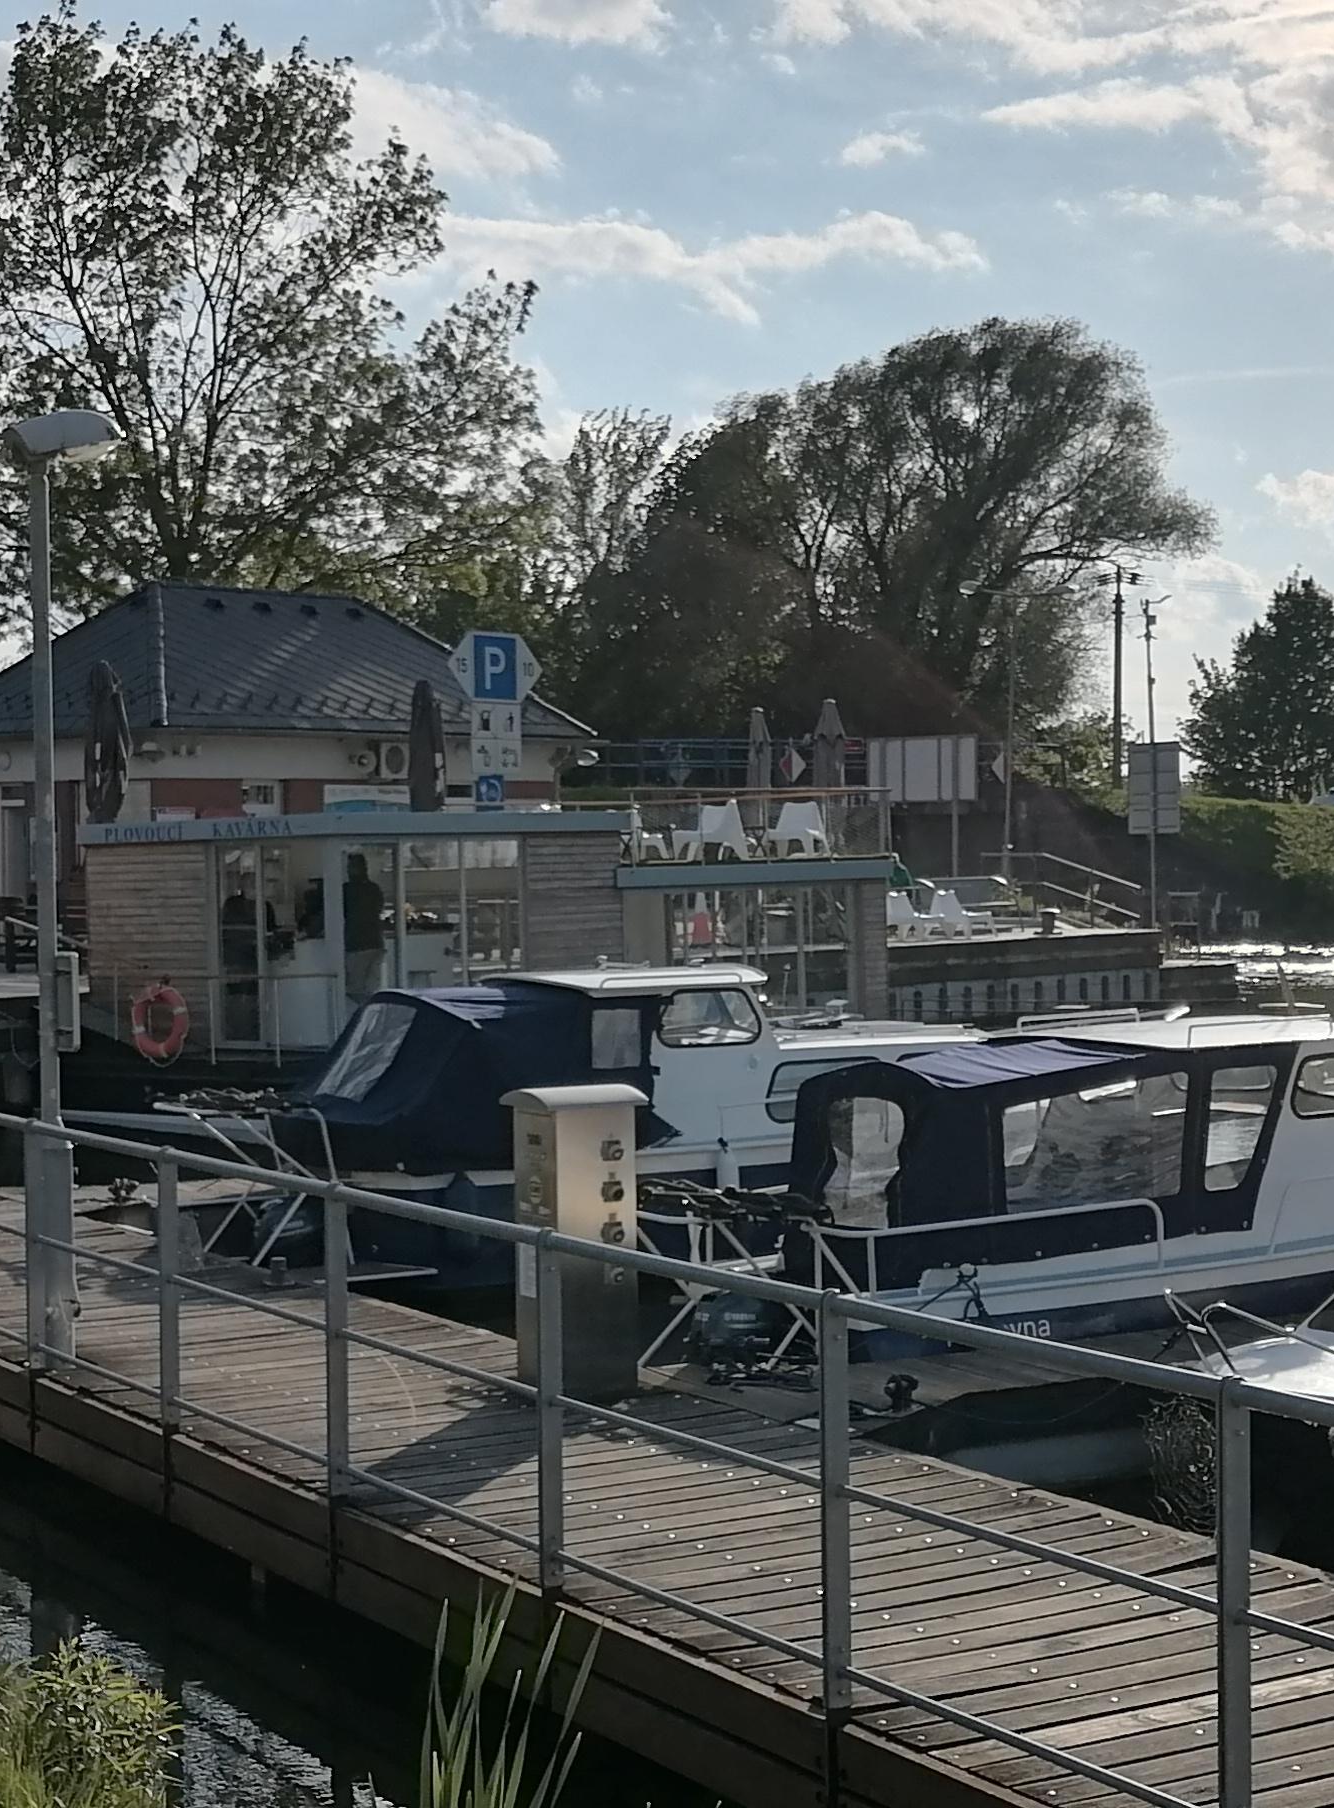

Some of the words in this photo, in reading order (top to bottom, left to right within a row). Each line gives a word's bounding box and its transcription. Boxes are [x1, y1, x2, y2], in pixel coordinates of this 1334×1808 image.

[456, 657, 468, 674] 15
[484, 646, 506, 690] P
[522, 661, 535, 677] 10
[104, 821, 184, 842] PLOVOUCÍ
[212, 815, 293, 838] KAVÁRNA
[1004, 1319, 1052, 1338] vna
